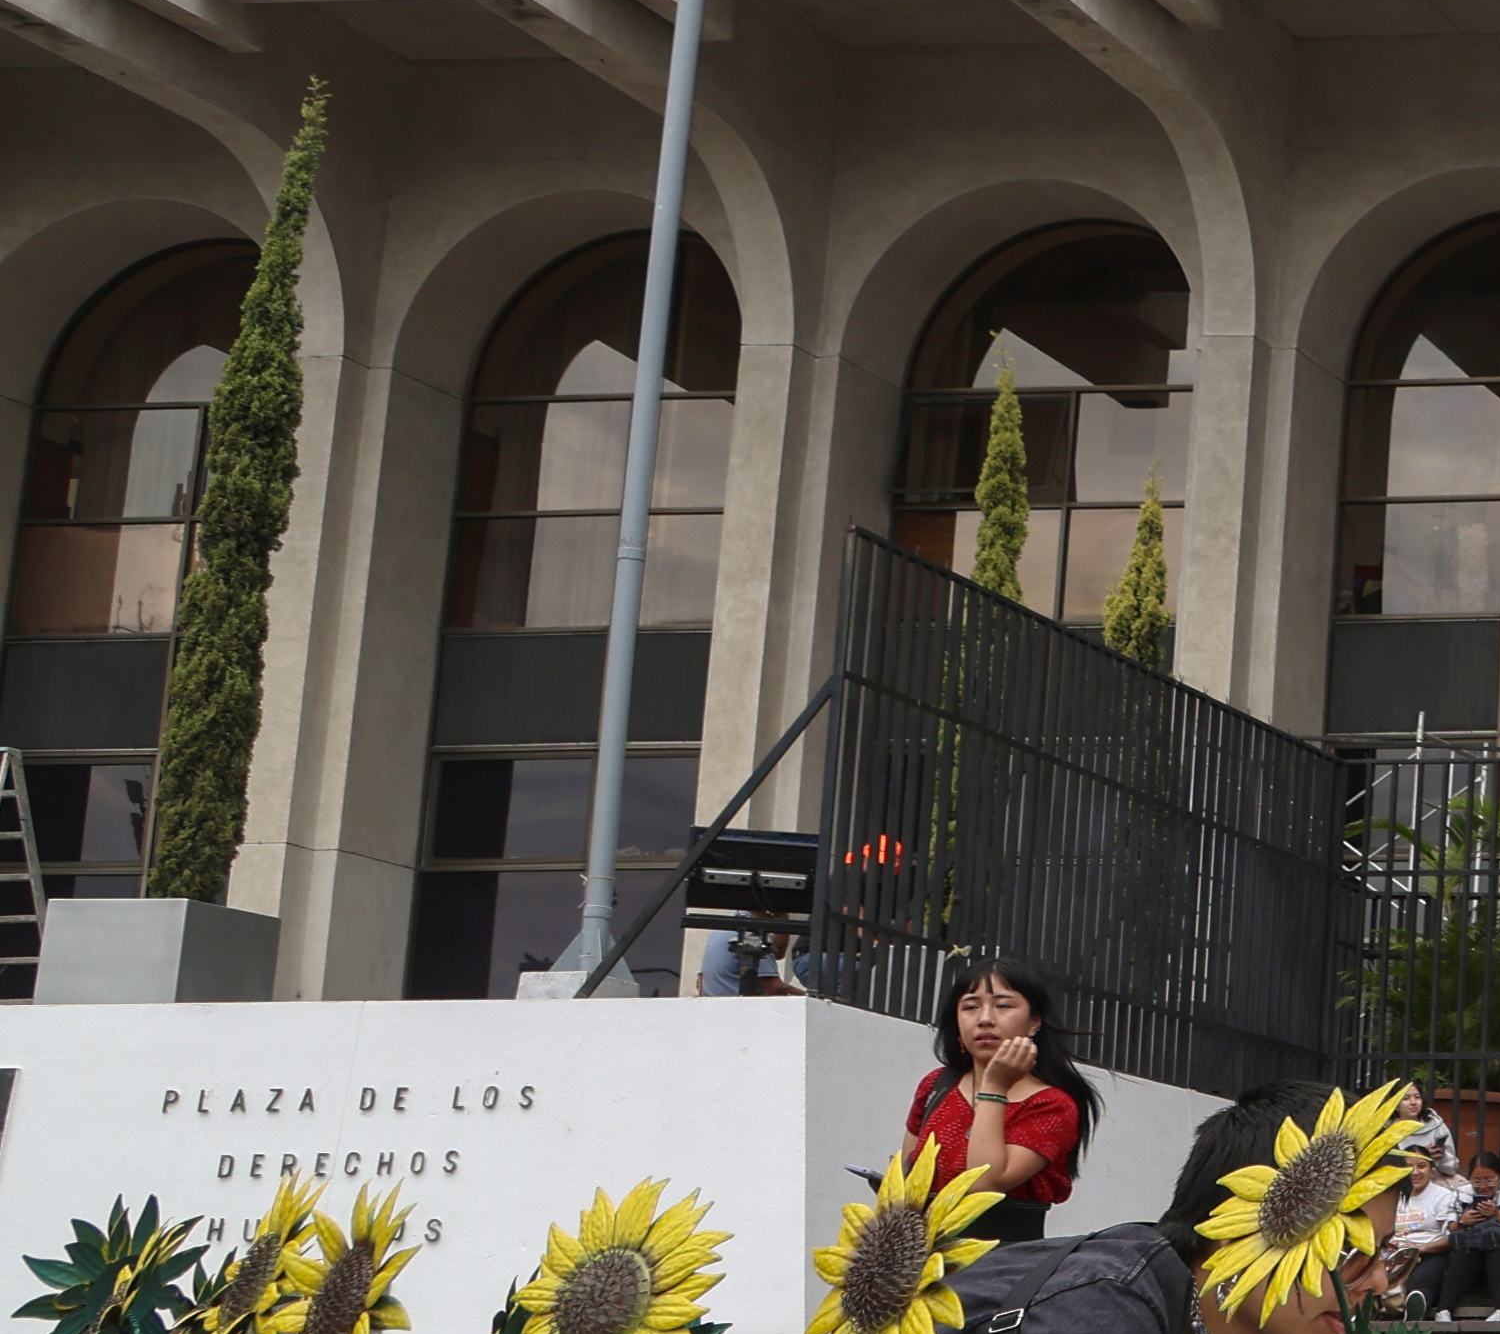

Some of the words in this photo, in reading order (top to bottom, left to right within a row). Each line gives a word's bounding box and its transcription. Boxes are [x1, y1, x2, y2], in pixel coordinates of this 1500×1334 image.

[161, 1088, 315, 1114] PLAZA
[359, 1086, 410, 1112] DE
[451, 1085, 536, 1111] LOS
[216, 1150, 461, 1180] DERECHOS
